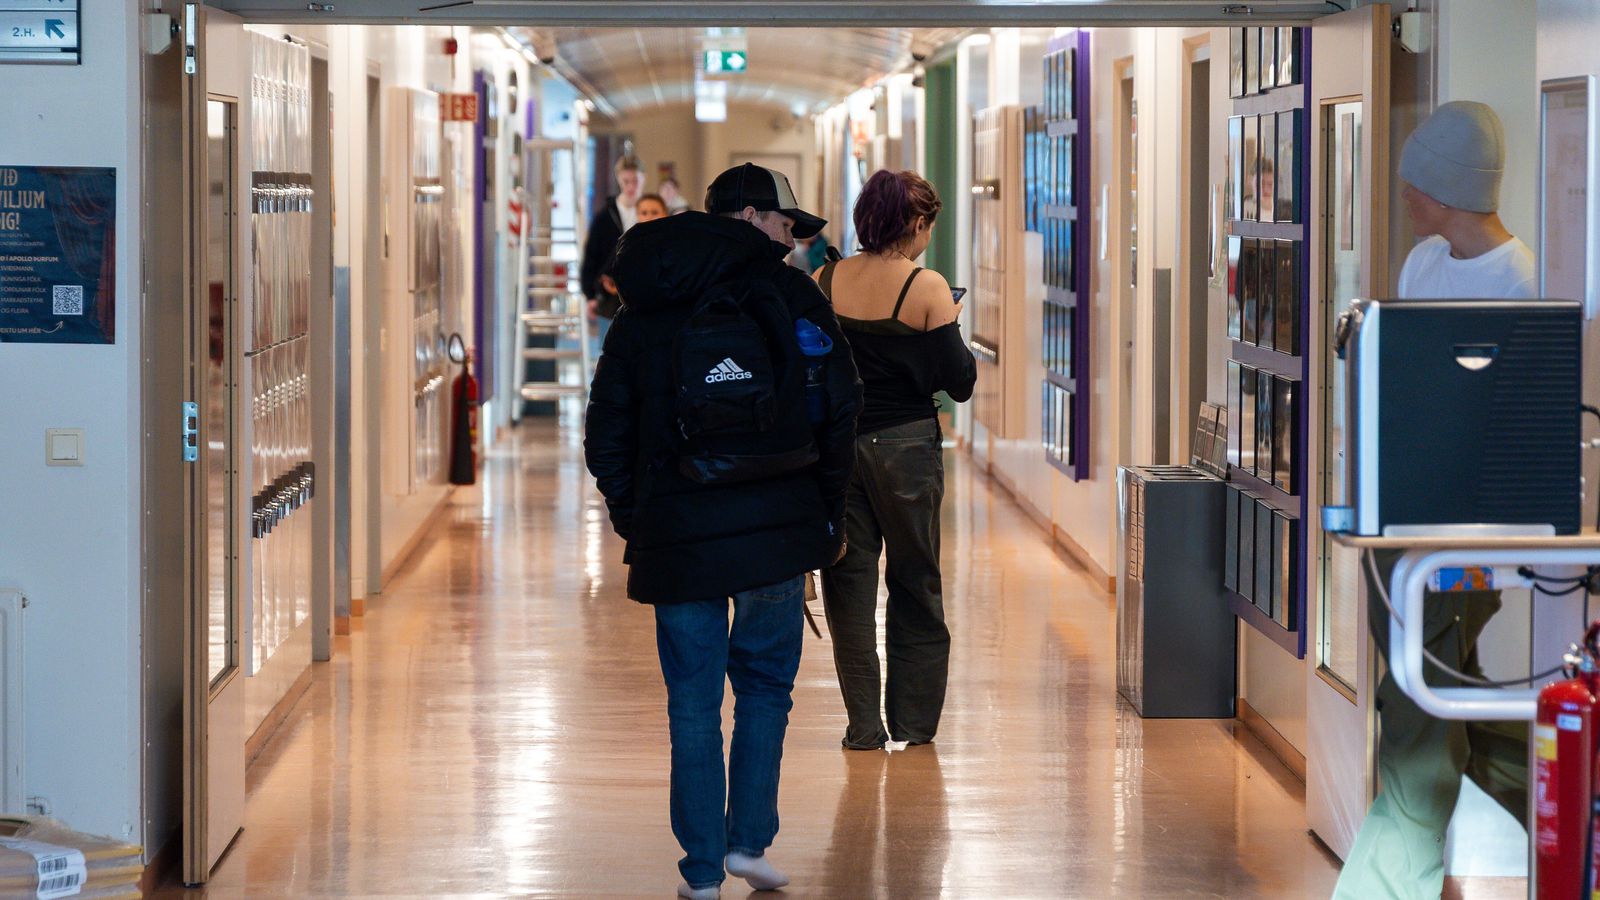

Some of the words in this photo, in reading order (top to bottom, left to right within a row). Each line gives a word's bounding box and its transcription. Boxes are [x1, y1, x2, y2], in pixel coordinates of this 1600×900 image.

[12, 27, 35, 37] 2.H.
[0, 212, 20, 230] IG!
[705, 371, 752, 383] adidas
